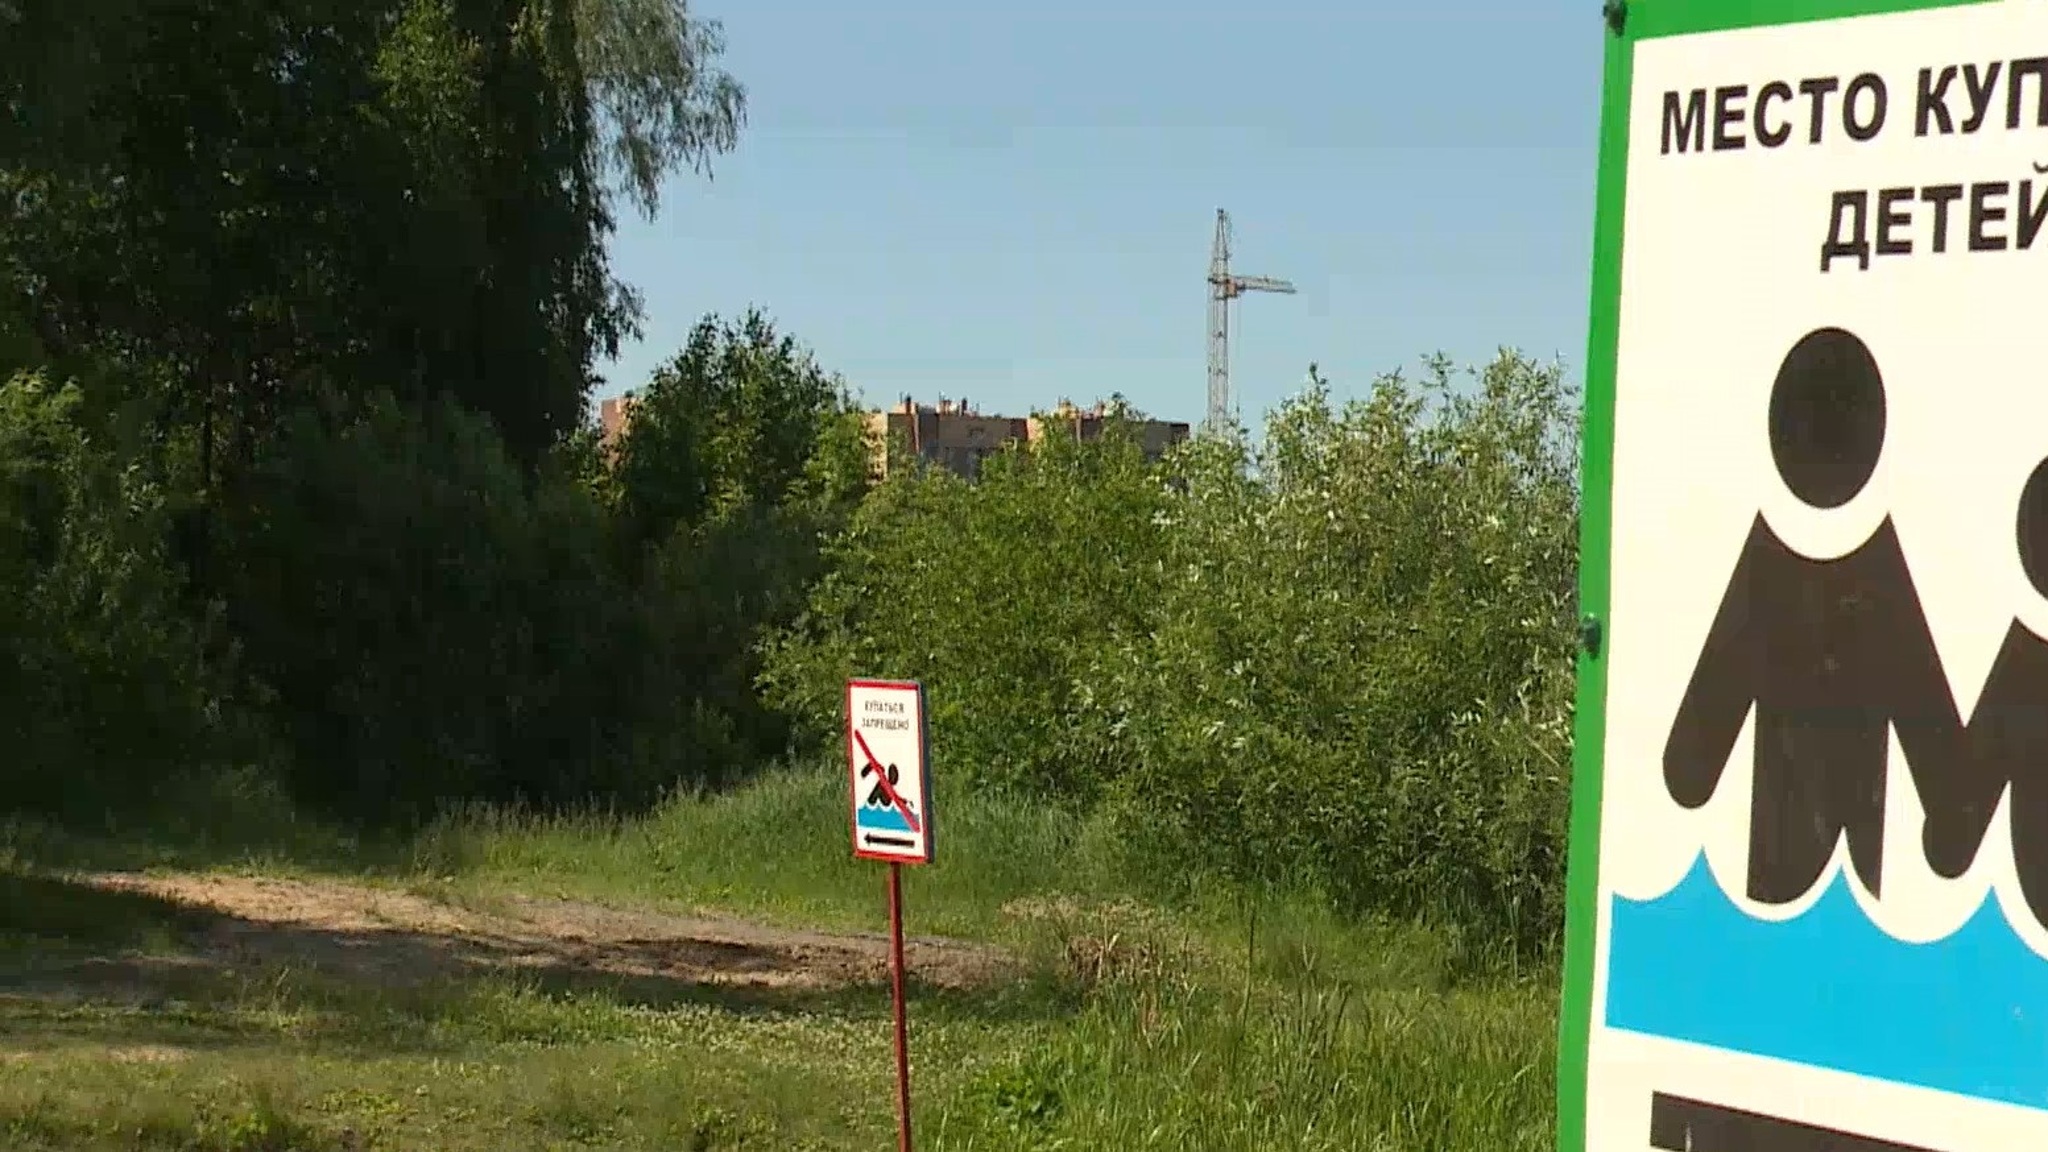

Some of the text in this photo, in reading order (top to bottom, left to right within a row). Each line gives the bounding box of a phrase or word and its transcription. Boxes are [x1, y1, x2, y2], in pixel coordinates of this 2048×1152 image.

[1660, 72, 1888, 154] МЕСТО
[864, 700, 904, 713] КУПАТЬСЯ
[861, 717, 909, 730] ЗАПРЕЩЕНО
